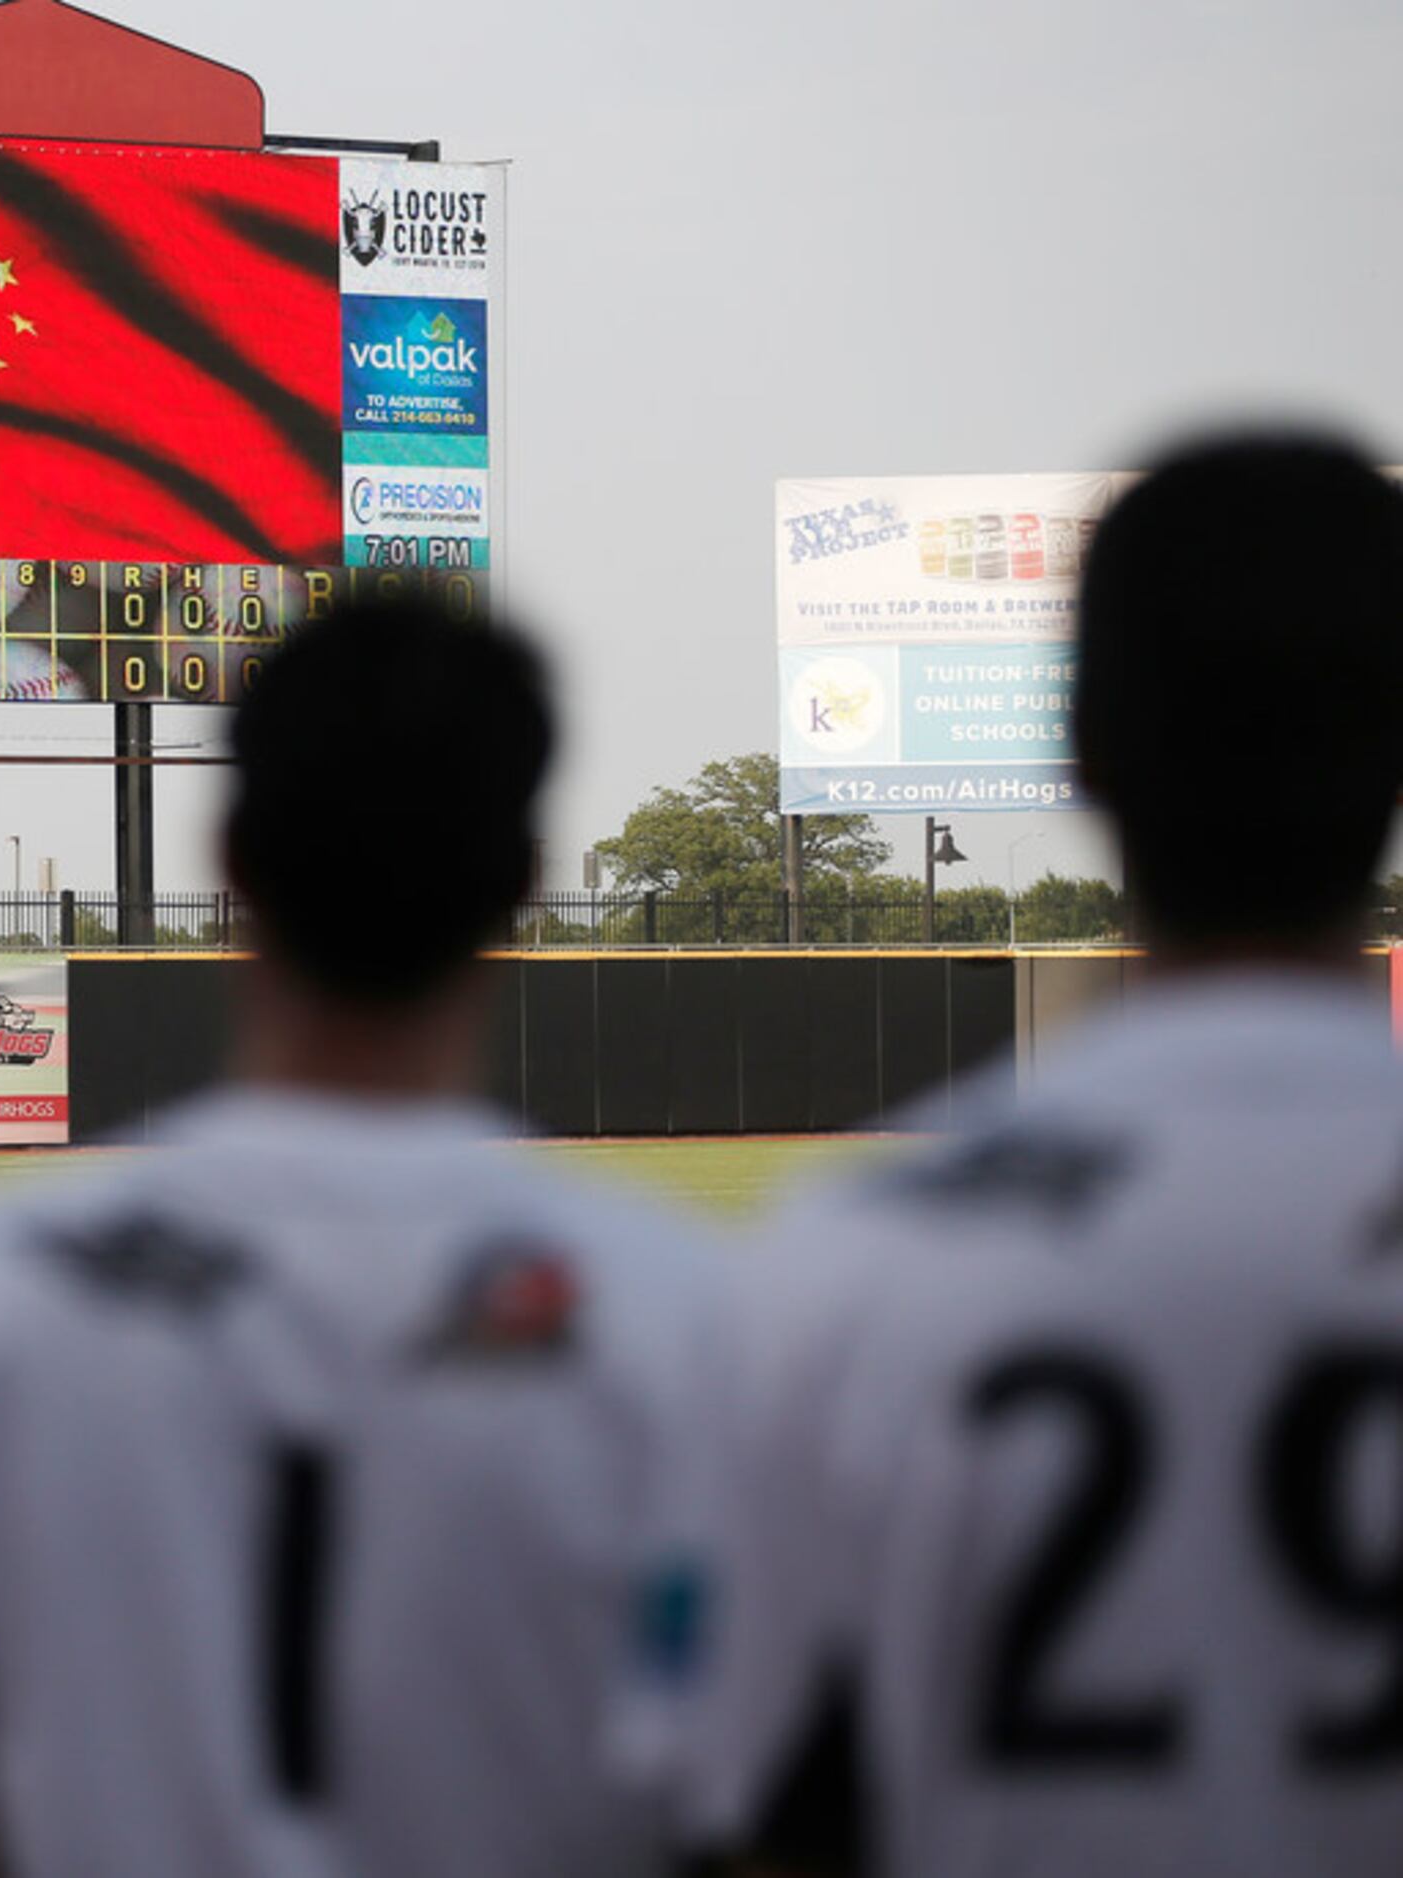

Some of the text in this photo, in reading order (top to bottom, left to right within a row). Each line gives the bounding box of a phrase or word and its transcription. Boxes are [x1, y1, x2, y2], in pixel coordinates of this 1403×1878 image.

[393, 189, 486, 222] LOCUST
[393, 224, 466, 255] CIDER
[350, 337, 478, 378] valpak
[355, 408, 388, 422] CALL
[366, 394, 385, 407] TO
[379, 482, 483, 511] PRECISION
[366, 536, 471, 567] 7:01 PM
[789, 521, 909, 565] PROJECT
[18, 562, 35, 585] 8
[70, 563, 86, 587] 9
[123, 564, 141, 588] R
[183, 565, 202, 589] H
[241, 567, 259, 590] E
[124, 593, 262, 631] 0 0 0
[797, 602, 842, 617] VISIT
[850, 601, 881, 617] THE
[886, 600, 922, 616] TAP
[927, 600, 979, 615] ROOM
[985, 598, 997, 615] &
[124, 656, 145, 691] 0
[184, 656, 204, 692] 0
[924, 663, 1077, 682] TUITION-FRE
[915, 694, 1004, 713] ONLINE
[950, 722, 1067, 742] SCHOOLS
[827, 778, 1073, 803] K12.com/AirHogs
[960, 1338, 1403, 1780] 29
[258, 1432, 338, 1806] 1
